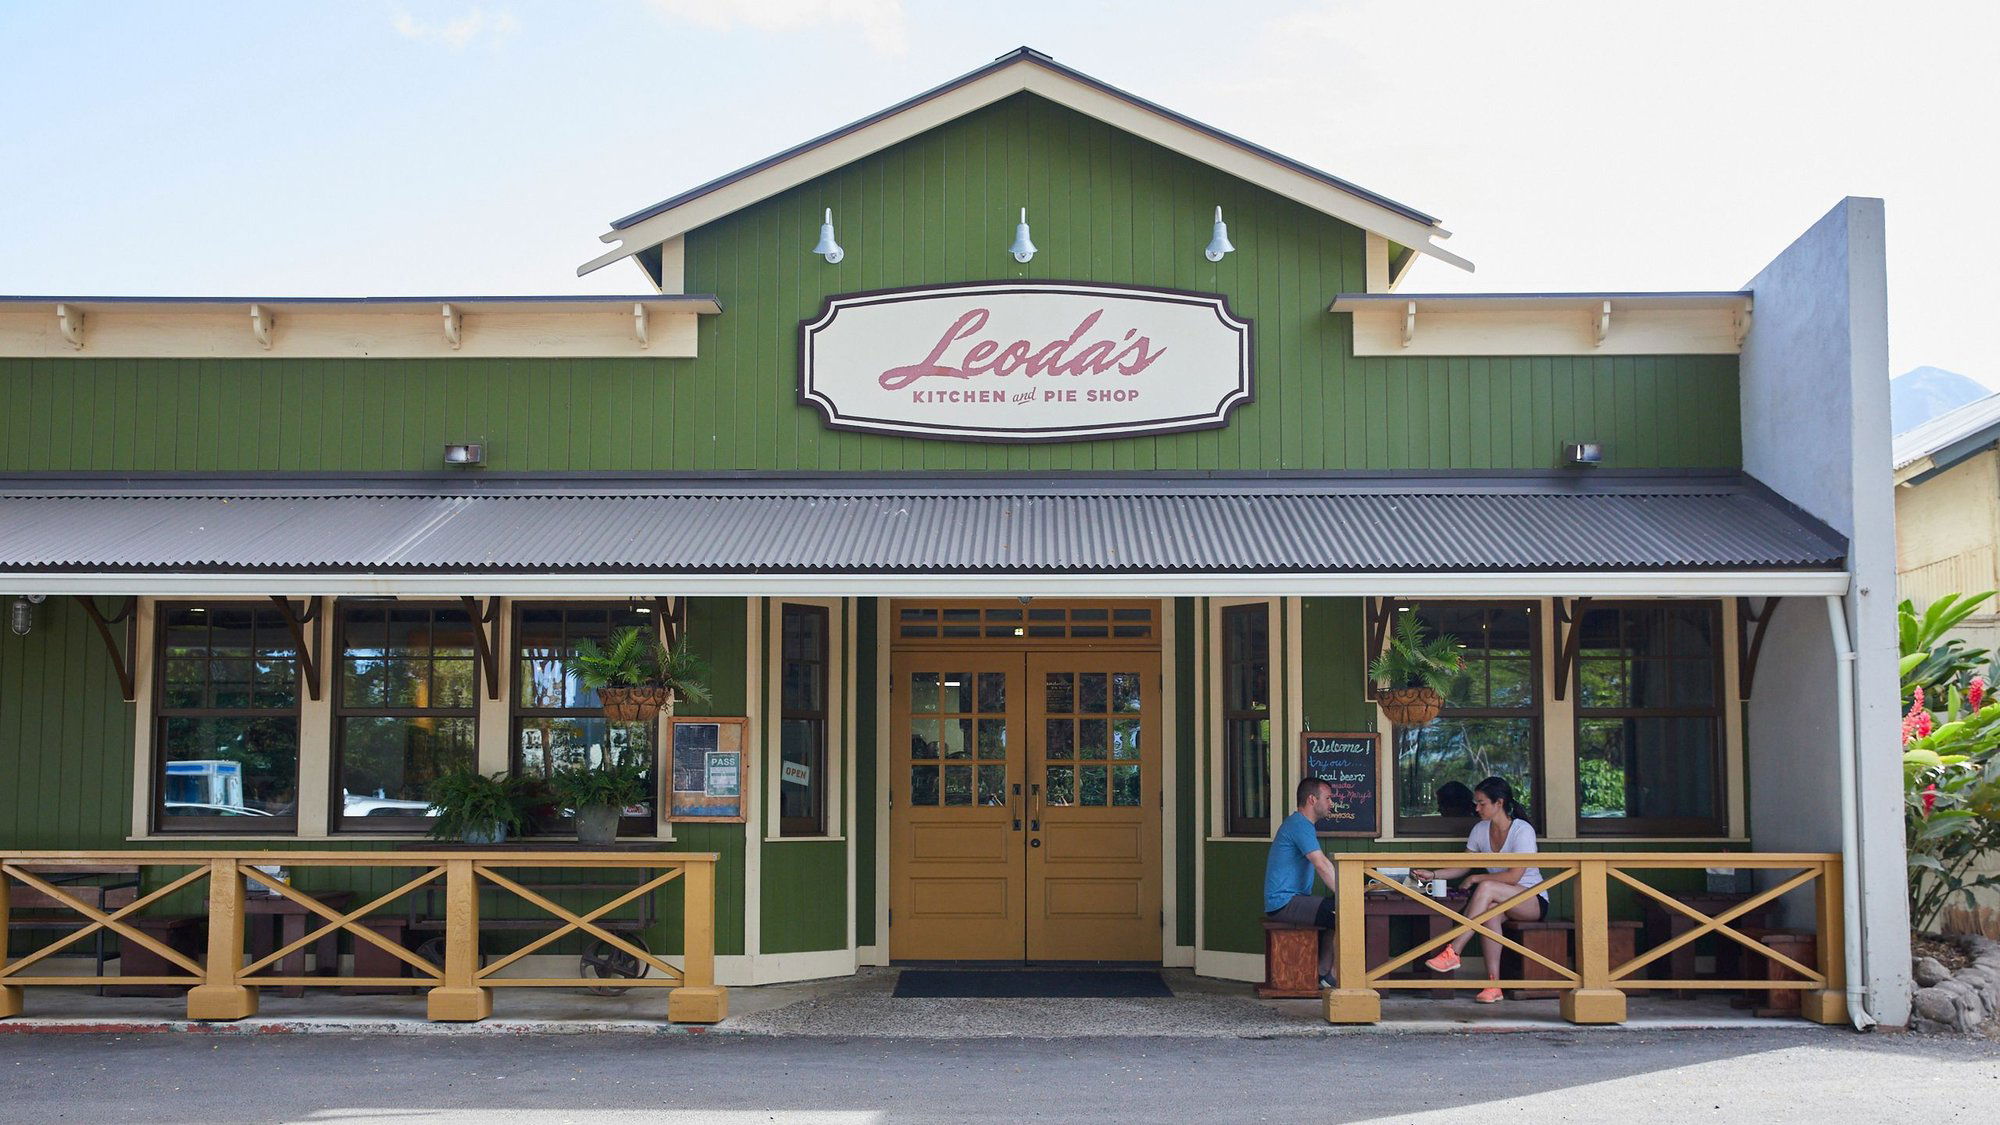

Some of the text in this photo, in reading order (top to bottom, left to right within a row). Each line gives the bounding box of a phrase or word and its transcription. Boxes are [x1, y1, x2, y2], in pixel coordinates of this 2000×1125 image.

[878, 308, 1168, 391] Leoda's
[912, 386, 1139, 405] KITCHEN and PIE SHOP
[711, 758, 736, 766] PASS
[1308, 755, 1328, 771] try
[785, 767, 806, 779] OPEN
[1340, 770, 1366, 782] beers
